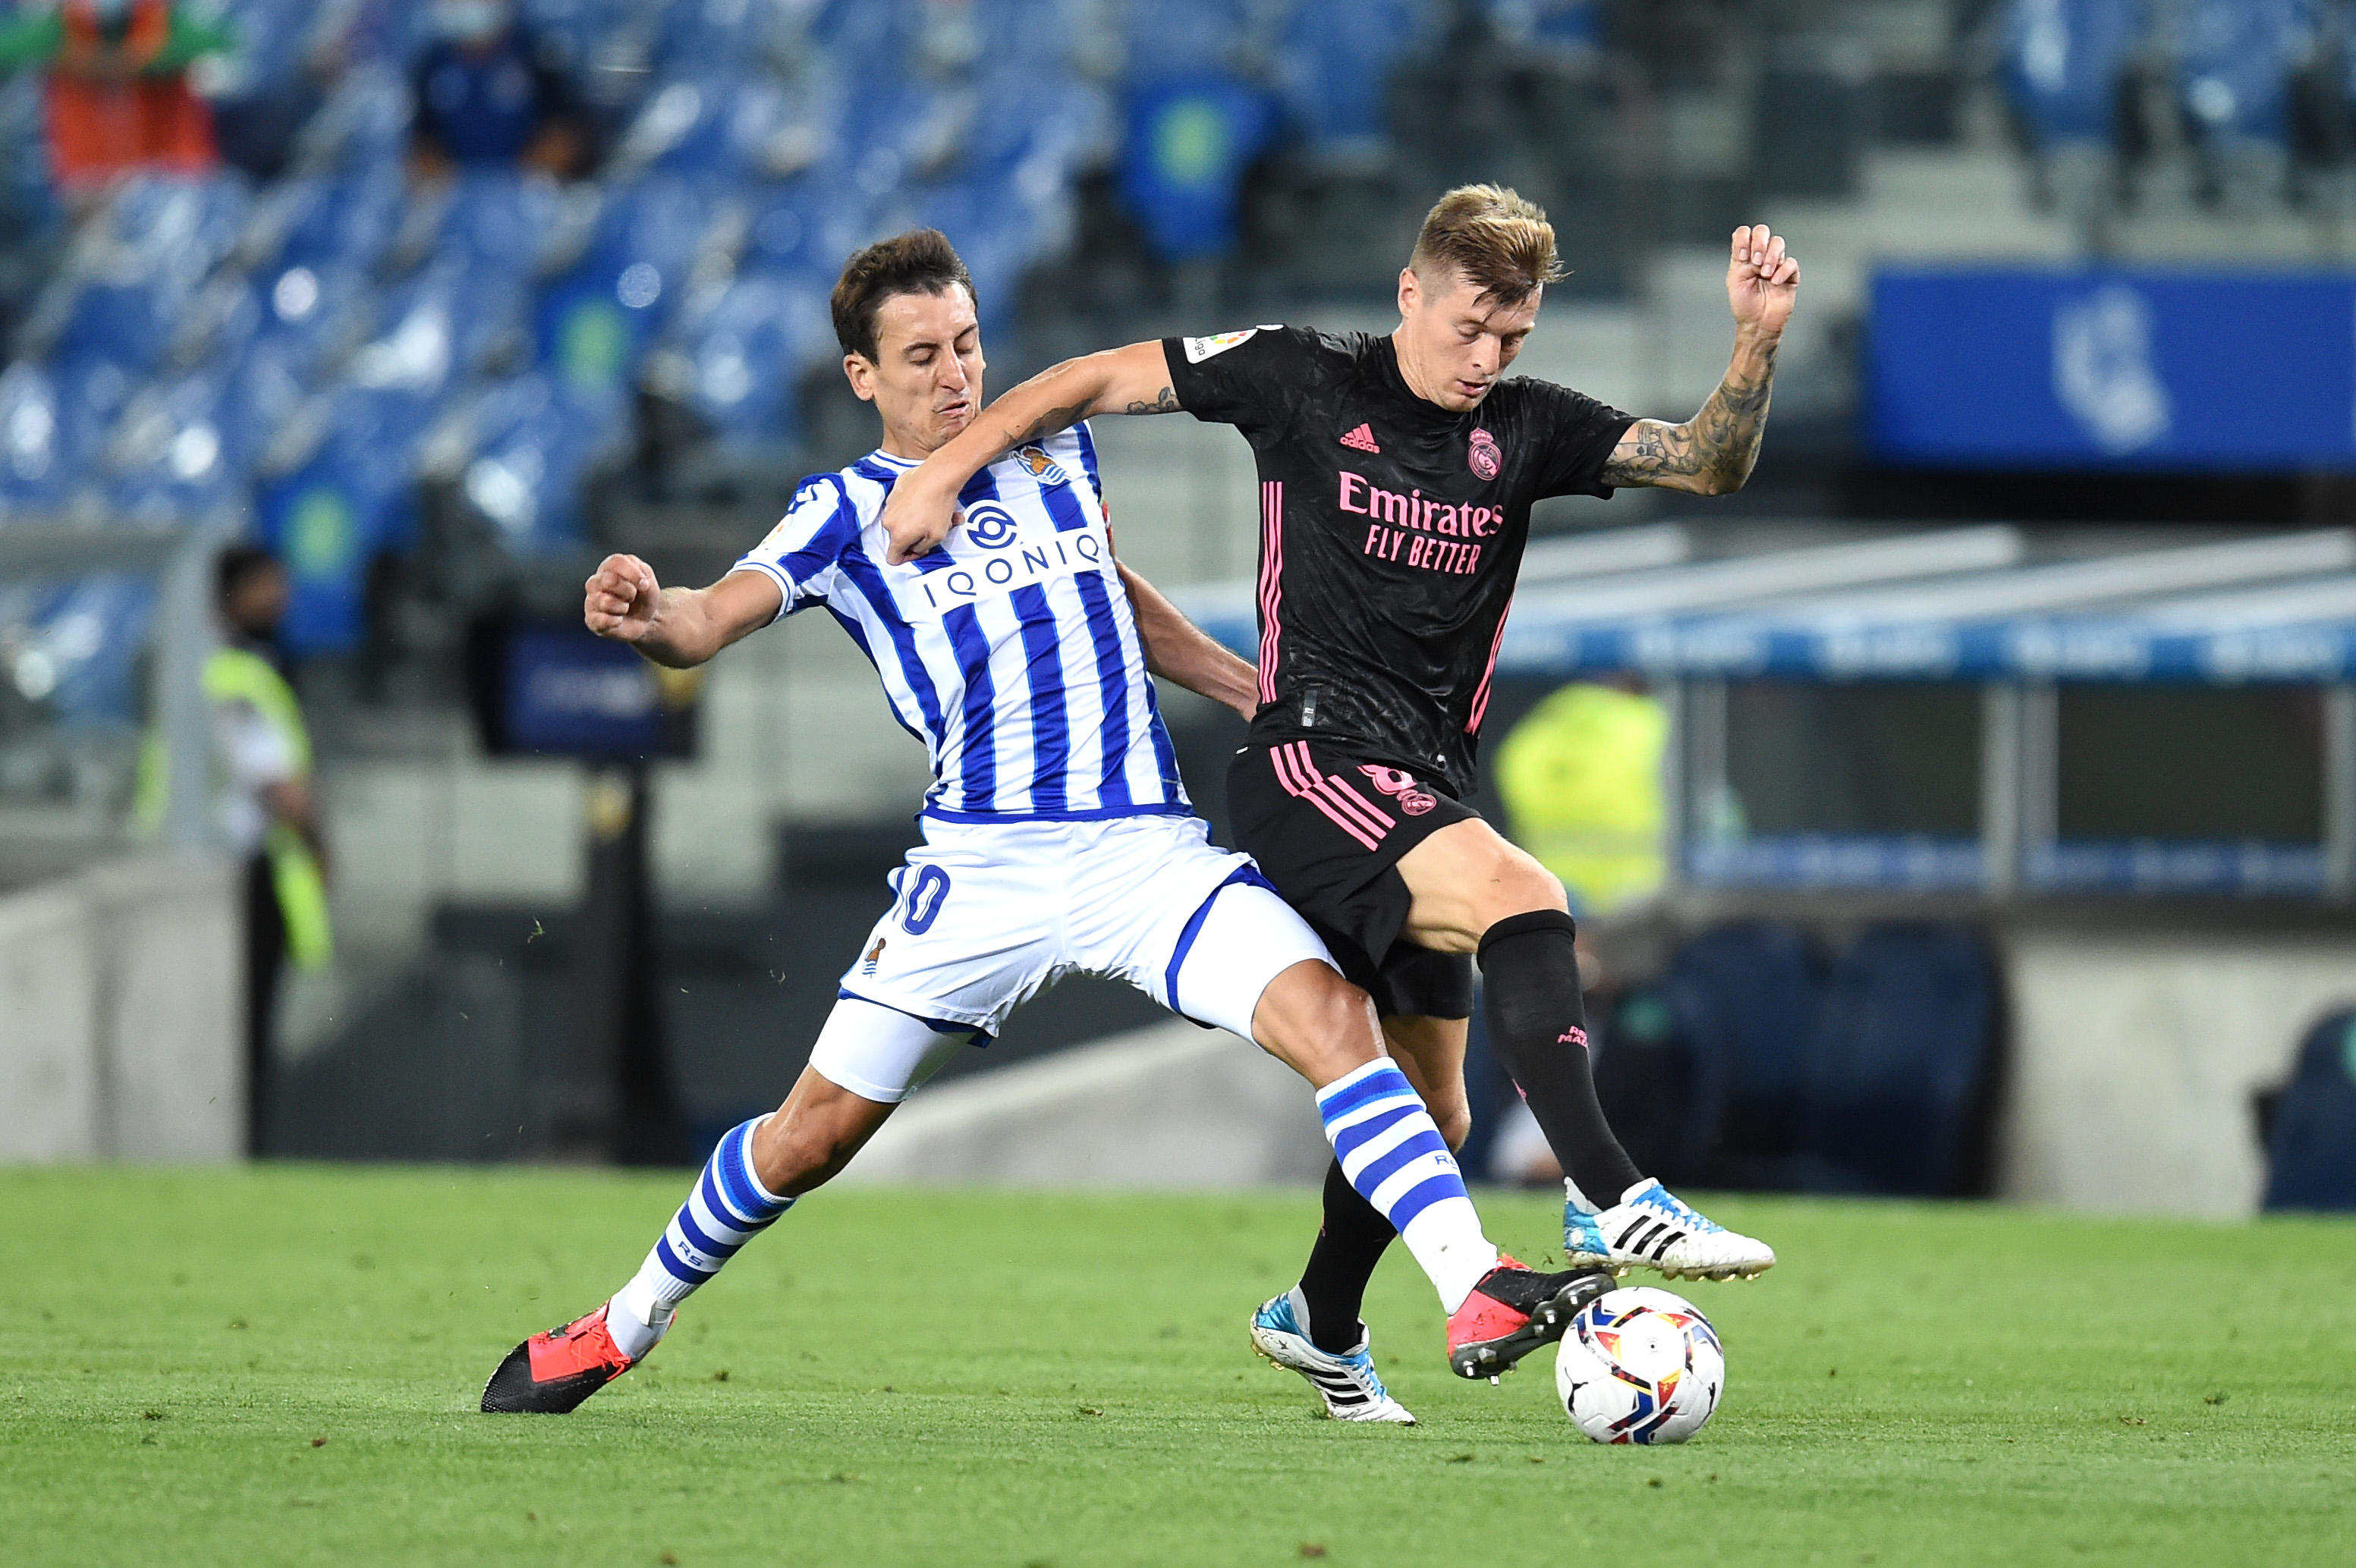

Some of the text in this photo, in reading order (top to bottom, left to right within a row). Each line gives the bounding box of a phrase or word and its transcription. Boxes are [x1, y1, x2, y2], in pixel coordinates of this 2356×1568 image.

[1339, 435, 1380, 454] adidas
[1338, 470, 1504, 537] Emirates
[923, 534, 1099, 608] IQONIQ
[1364, 524, 1482, 574] FLY BETTER
[678, 1240, 703, 1267] RS
